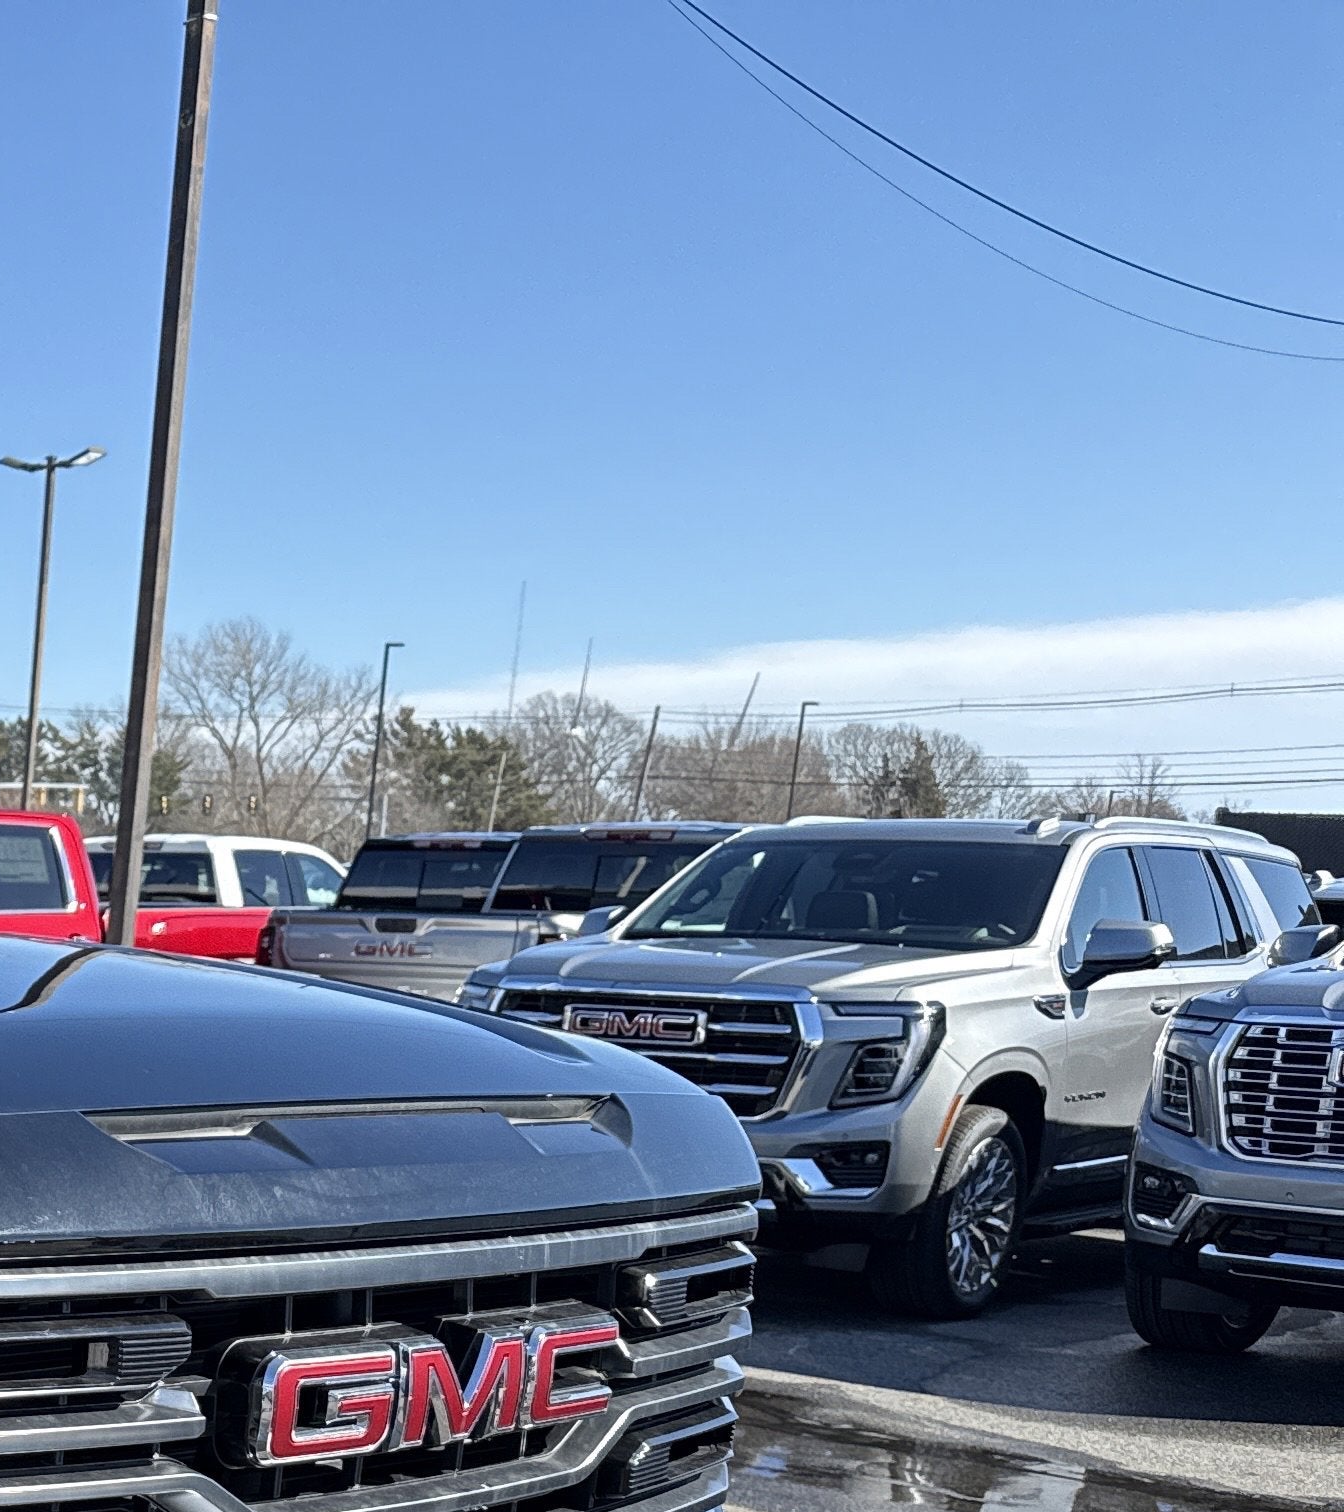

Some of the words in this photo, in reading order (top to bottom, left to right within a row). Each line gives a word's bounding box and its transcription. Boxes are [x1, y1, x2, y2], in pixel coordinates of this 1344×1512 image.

[353, 936, 434, 958] GMC
[569, 1009, 696, 1040] GMC
[267, 1314, 620, 1464] GMC
